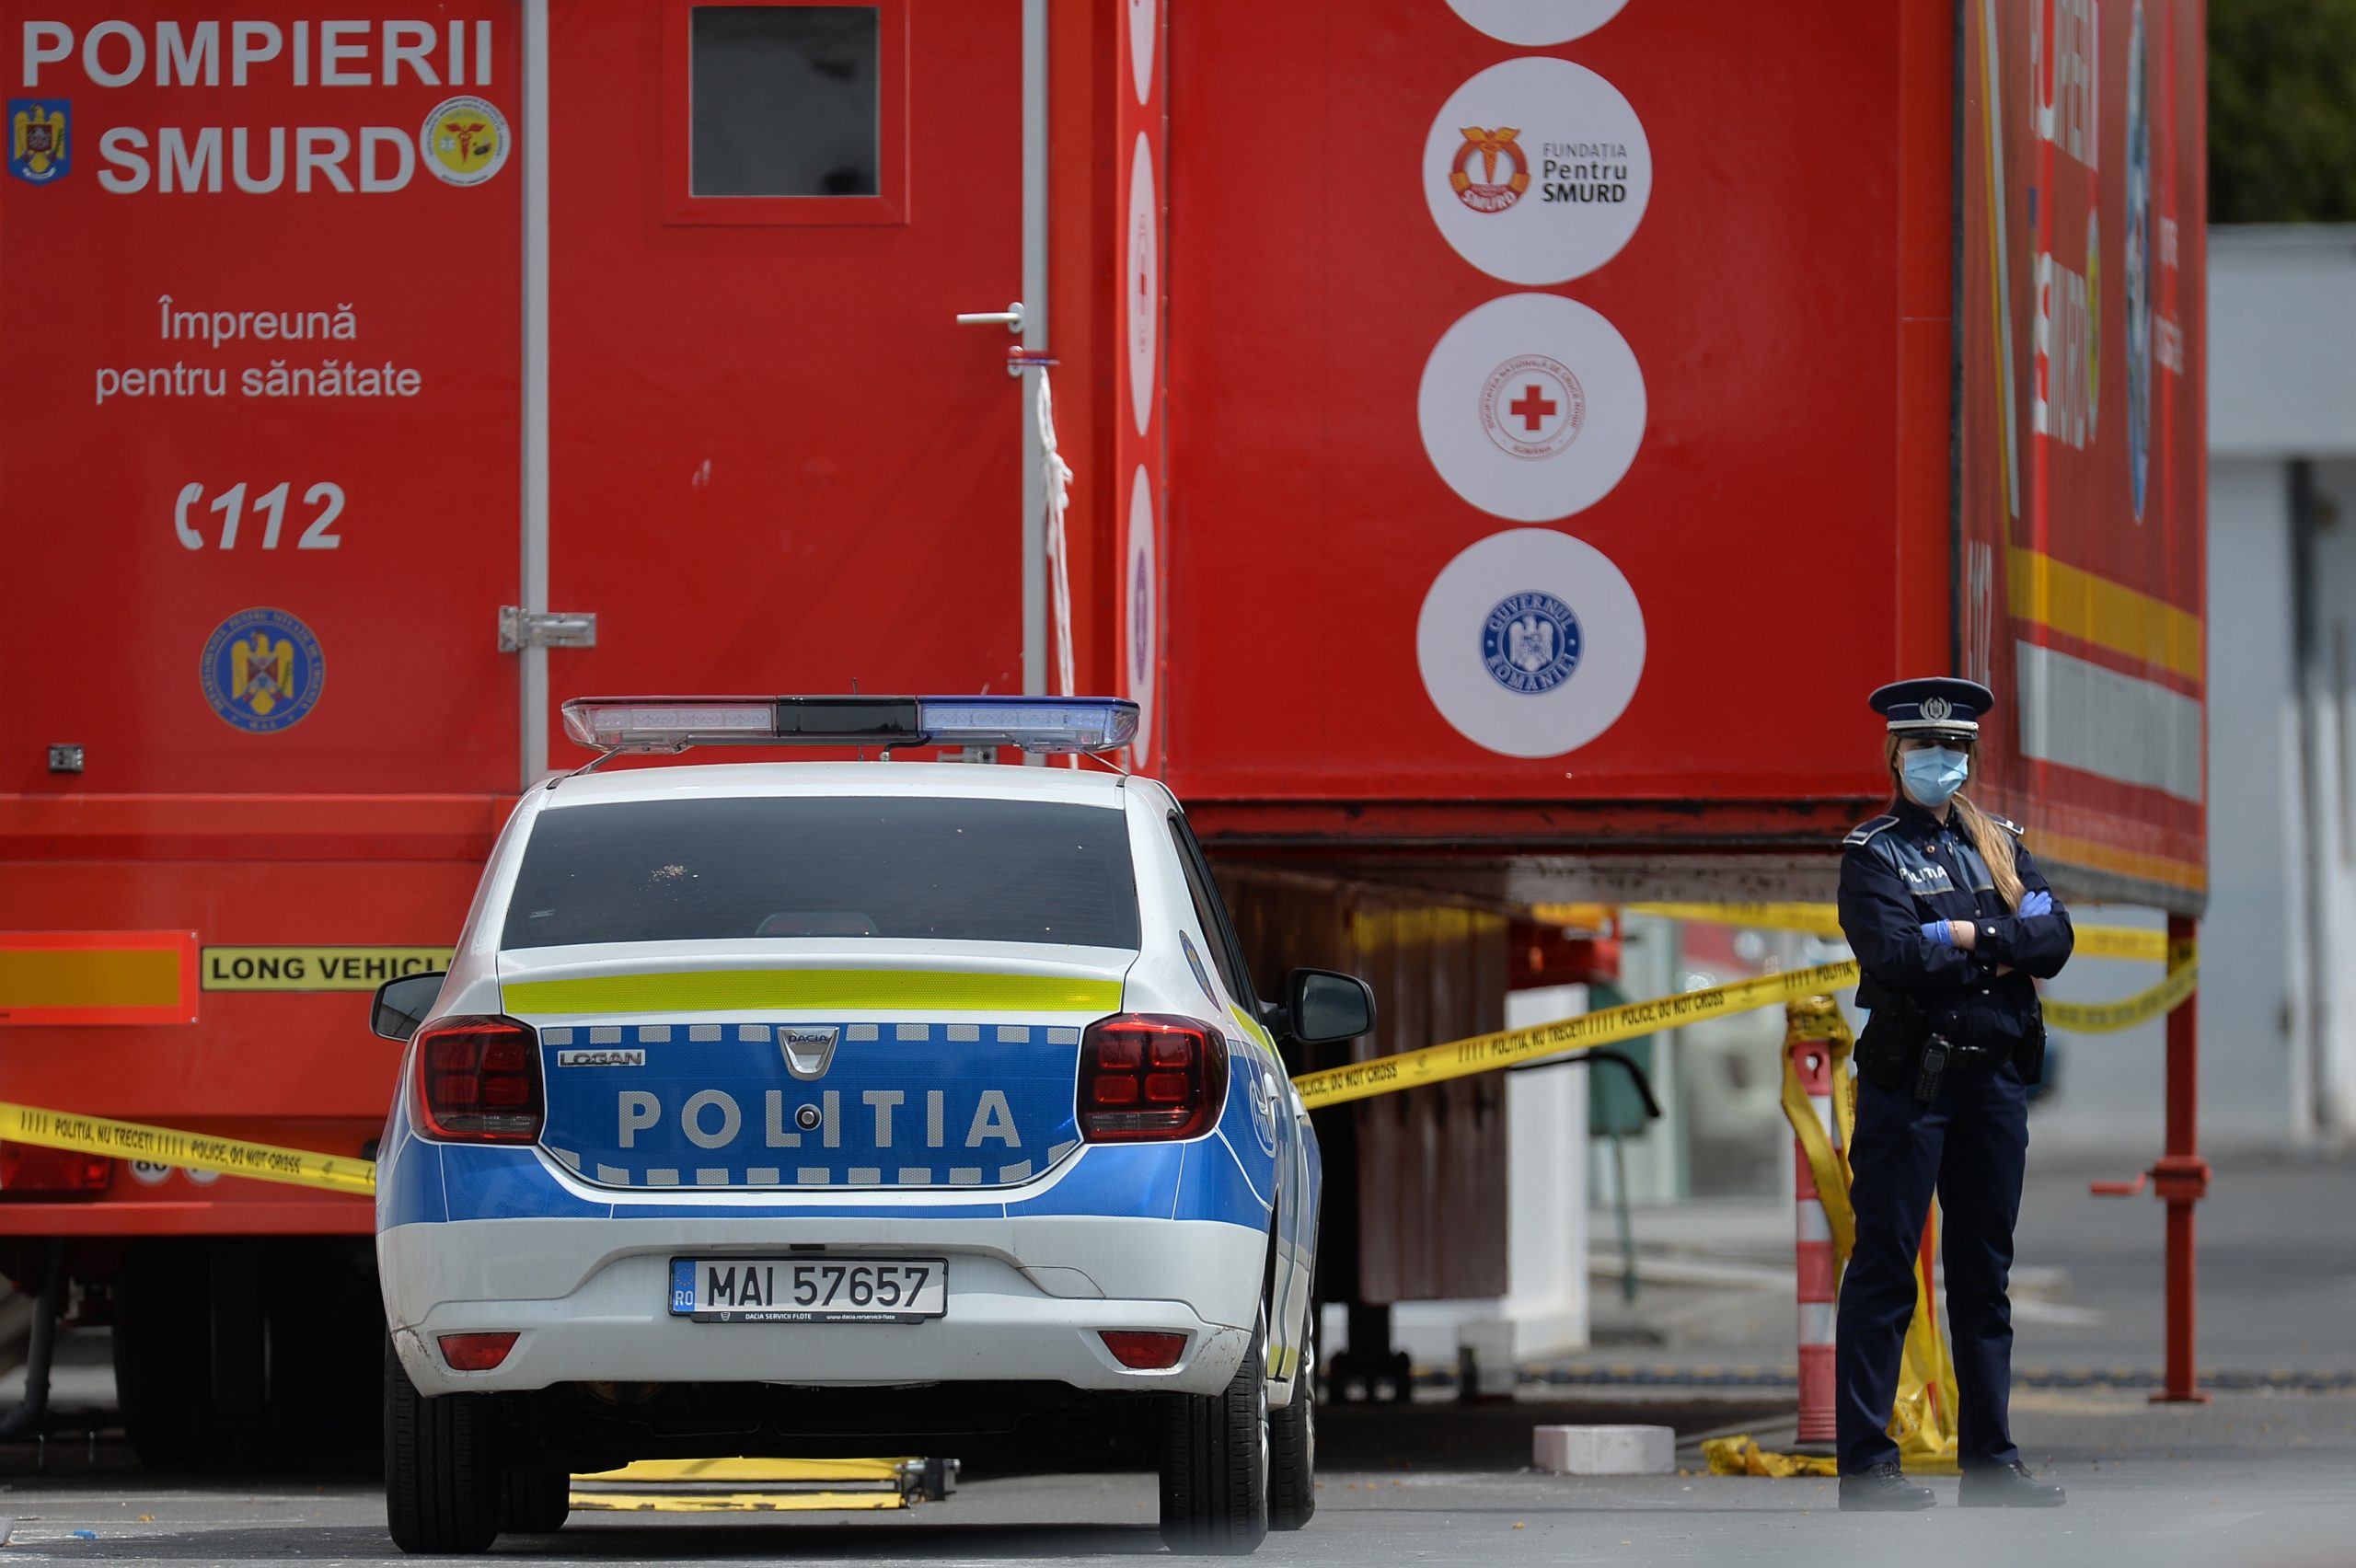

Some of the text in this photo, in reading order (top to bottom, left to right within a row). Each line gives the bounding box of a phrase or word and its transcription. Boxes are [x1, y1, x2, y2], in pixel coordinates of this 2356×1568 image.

[23, 20, 492, 88] POMPIERII
[98, 127, 416, 195] SMURD
[1543, 158, 1627, 179] Pentru
[1542, 182, 1627, 203] SMURD
[158, 294, 358, 349] Împreună
[96, 360, 422, 405] pentru sănătate
[210, 482, 346, 550] 112
[212, 957, 306, 981] LONG
[559, 1051, 643, 1066] LOGAN
[788, 1033, 828, 1043] DACIA
[618, 1088, 1022, 1150] POLITIA
[674, 1290, 694, 1307] RO
[708, 1266, 930, 1308] MAI 57657
